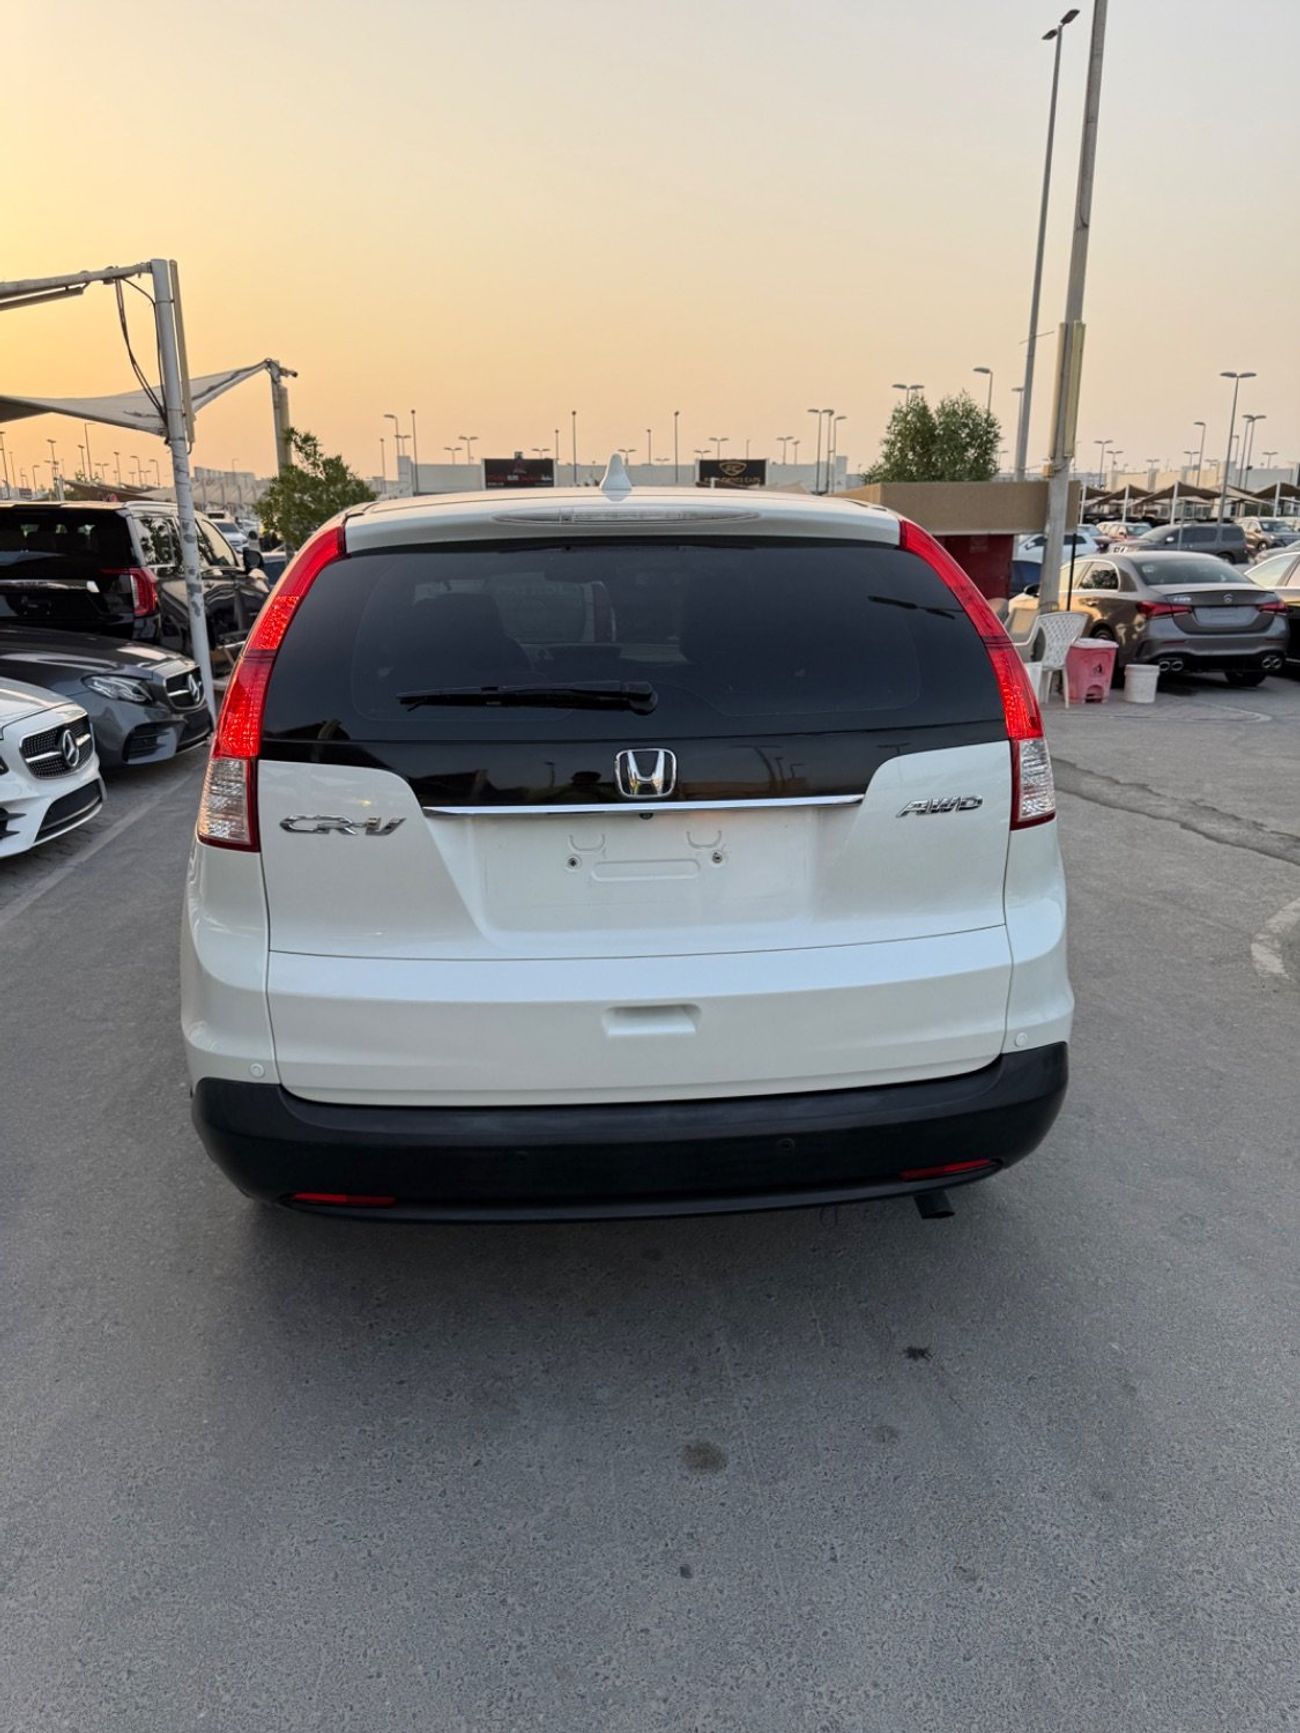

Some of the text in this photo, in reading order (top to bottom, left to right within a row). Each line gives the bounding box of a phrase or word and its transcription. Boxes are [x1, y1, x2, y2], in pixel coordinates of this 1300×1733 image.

[626, 749, 666, 797] H
[896, 795, 983, 818] AWD
[280, 814, 407, 836] CR-V
